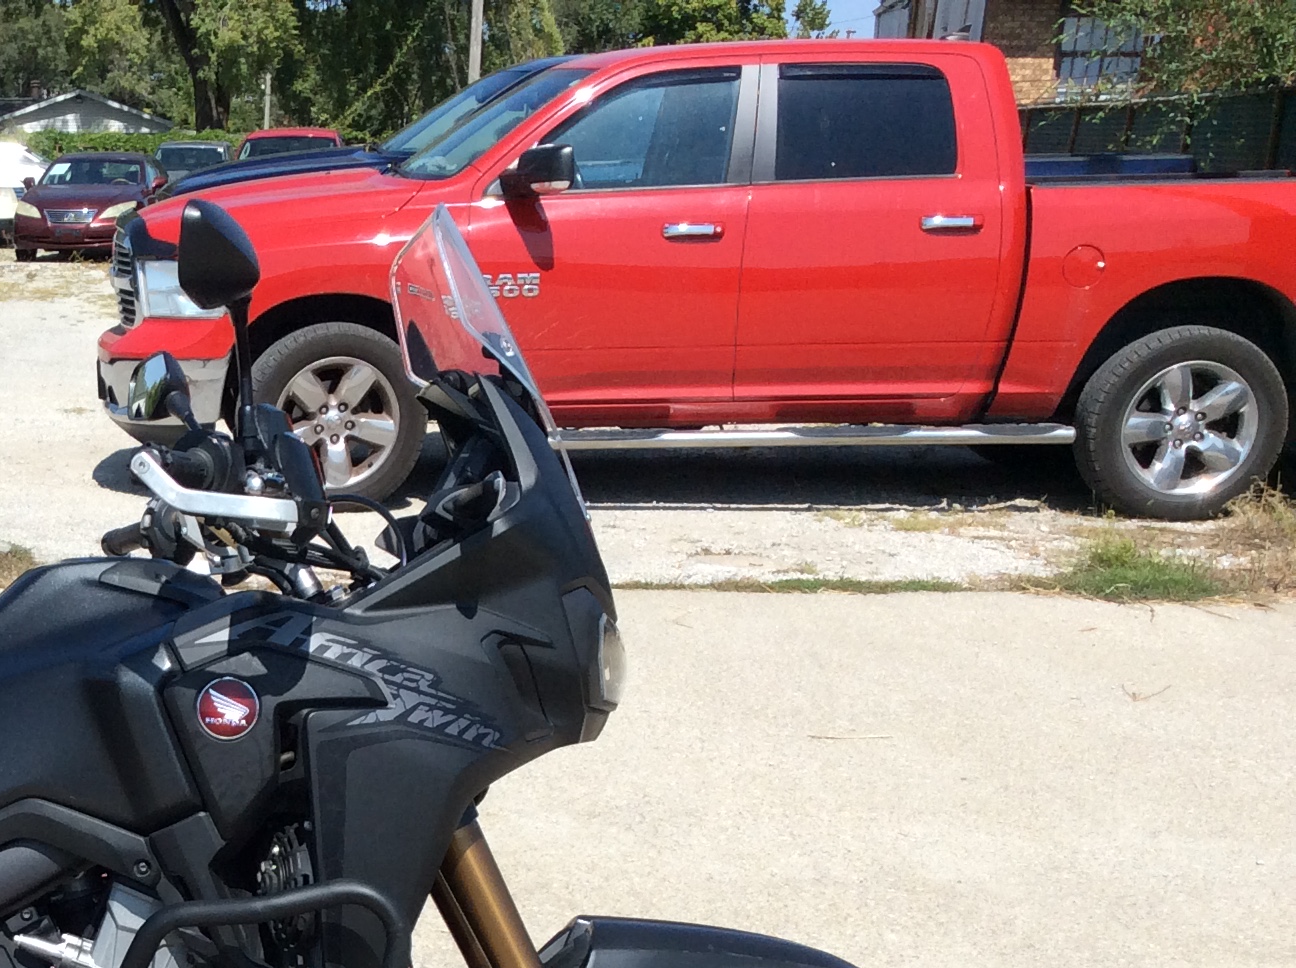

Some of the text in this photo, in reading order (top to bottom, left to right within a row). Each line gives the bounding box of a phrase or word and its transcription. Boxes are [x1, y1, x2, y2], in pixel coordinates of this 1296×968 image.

[488, 285, 541, 298] 500
[194, 609, 456, 700] Africa
[205, 716, 249, 728] HONDA
[346, 688, 508, 749] Twin
